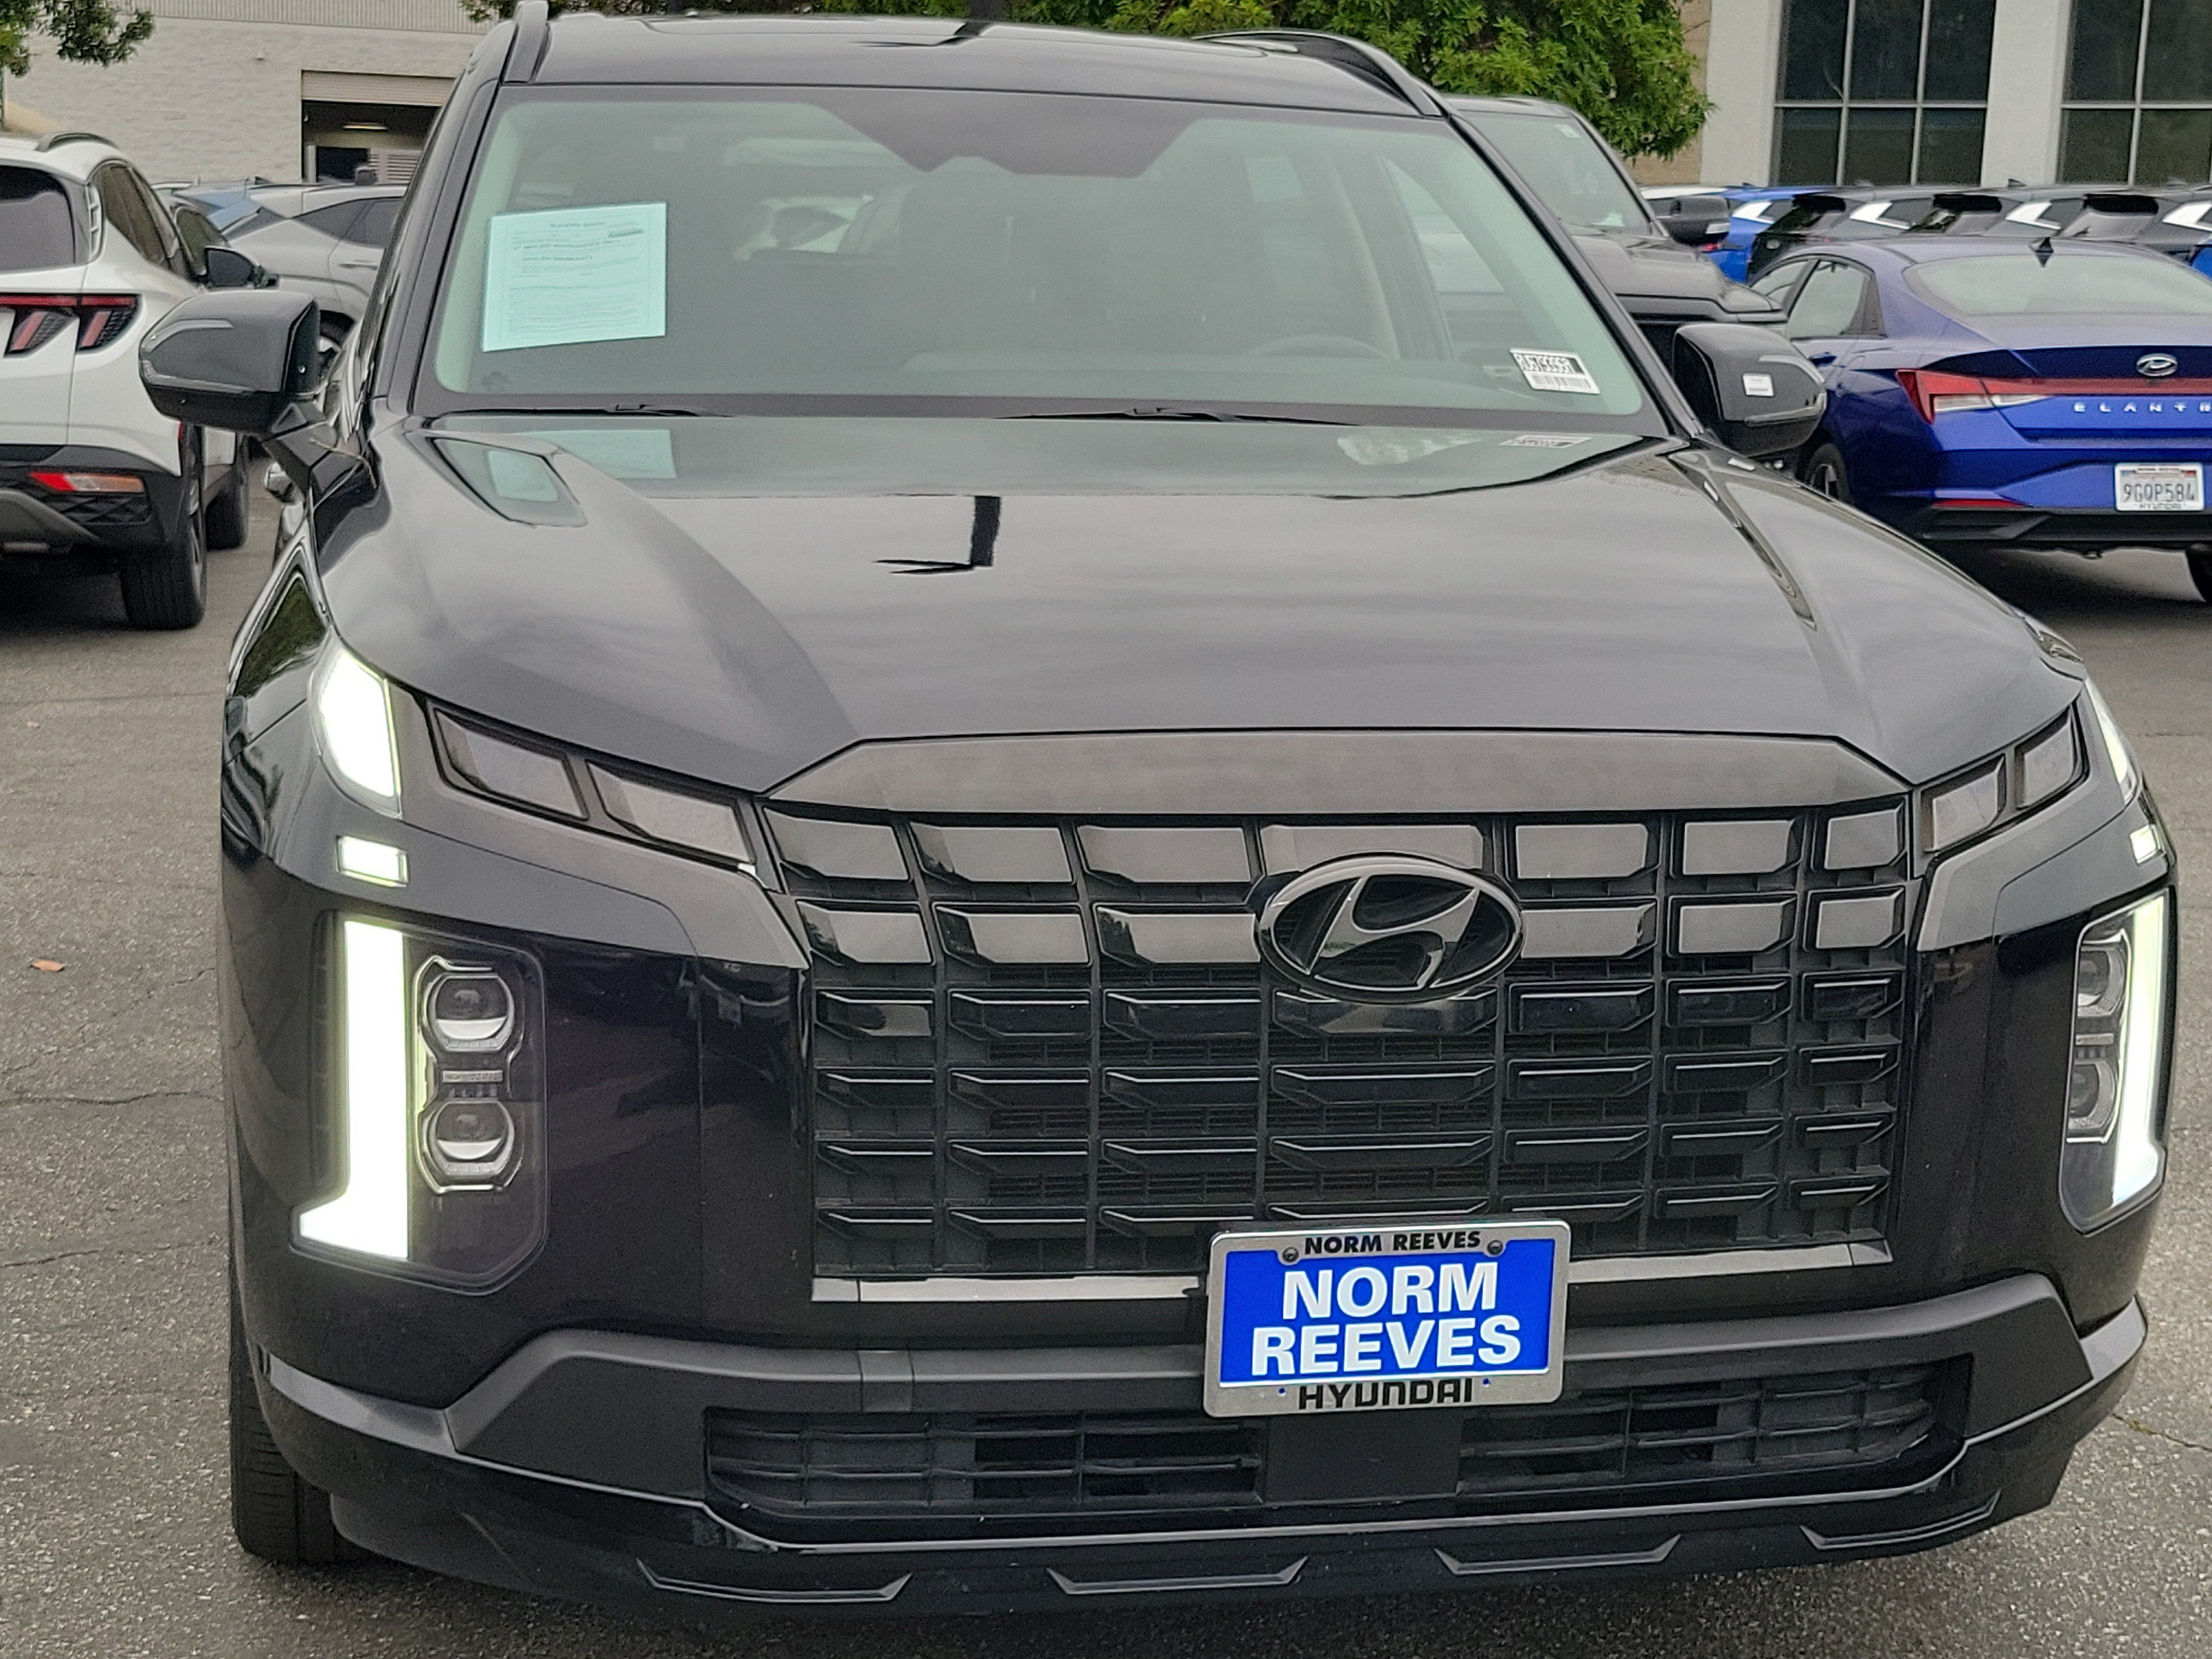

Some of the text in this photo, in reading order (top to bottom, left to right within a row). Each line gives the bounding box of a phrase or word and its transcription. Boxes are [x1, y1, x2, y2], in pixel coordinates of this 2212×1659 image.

[2124, 483, 2194, 502] 9GQP584
[1304, 1231, 1481, 1255] NORM REEVES
[1283, 1262, 1498, 1319] NORM
[1252, 1315, 1521, 1376] REEVES
[1298, 1378, 1472, 1409] HYUNDAI
